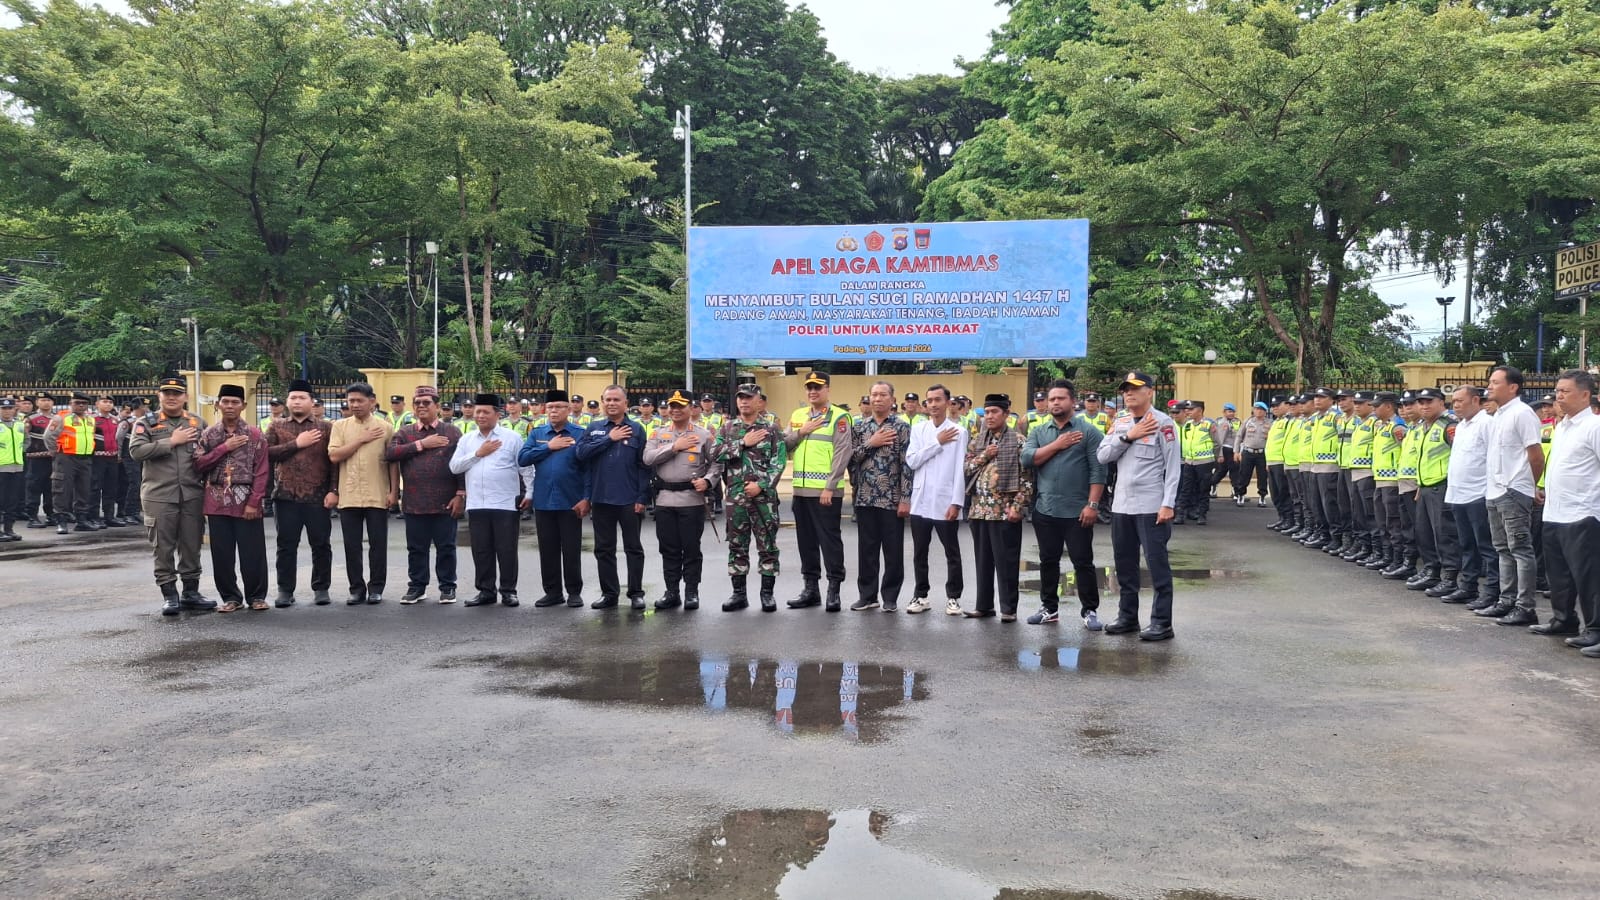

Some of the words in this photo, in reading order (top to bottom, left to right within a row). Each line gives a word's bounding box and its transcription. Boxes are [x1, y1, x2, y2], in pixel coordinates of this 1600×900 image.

[1561, 244, 1598, 267] POLISI
[771, 258, 815, 275] APEL
[820, 256, 880, 274] SIAGA
[886, 254, 999, 273] KAMTIBMAS
[1559, 264, 1599, 286] POLICE
[840, 281, 877, 290] DALAM
[880, 280, 926, 289] RANGKA
[705, 294, 805, 307] MENYAMBUT
[810, 293, 864, 306] BULAN
[869, 292, 907, 305] SUCI
[913, 291, 1007, 305] RAMADHAN
[1013, 290, 1052, 303] 1447
[1057, 290, 1070, 303] H
[714, 309, 765, 320] PADANG
[769, 309, 809, 321] AMAN,
[812, 308, 893, 320] MASYARAKAT
[896, 307, 948, 319] TENANG,
[952, 307, 998, 318] IBADAH
[1002, 305, 1059, 317] NYAMAN
[788, 325, 828, 335] POLRI
[832, 325, 881, 335] UNTUK
[885, 323, 979, 334] MASYARAKAT
[834, 345, 867, 354] Padang,
[869, 345, 878, 353] 17
[879, 344, 912, 353] Februari
[913, 344, 933, 353] 2026
